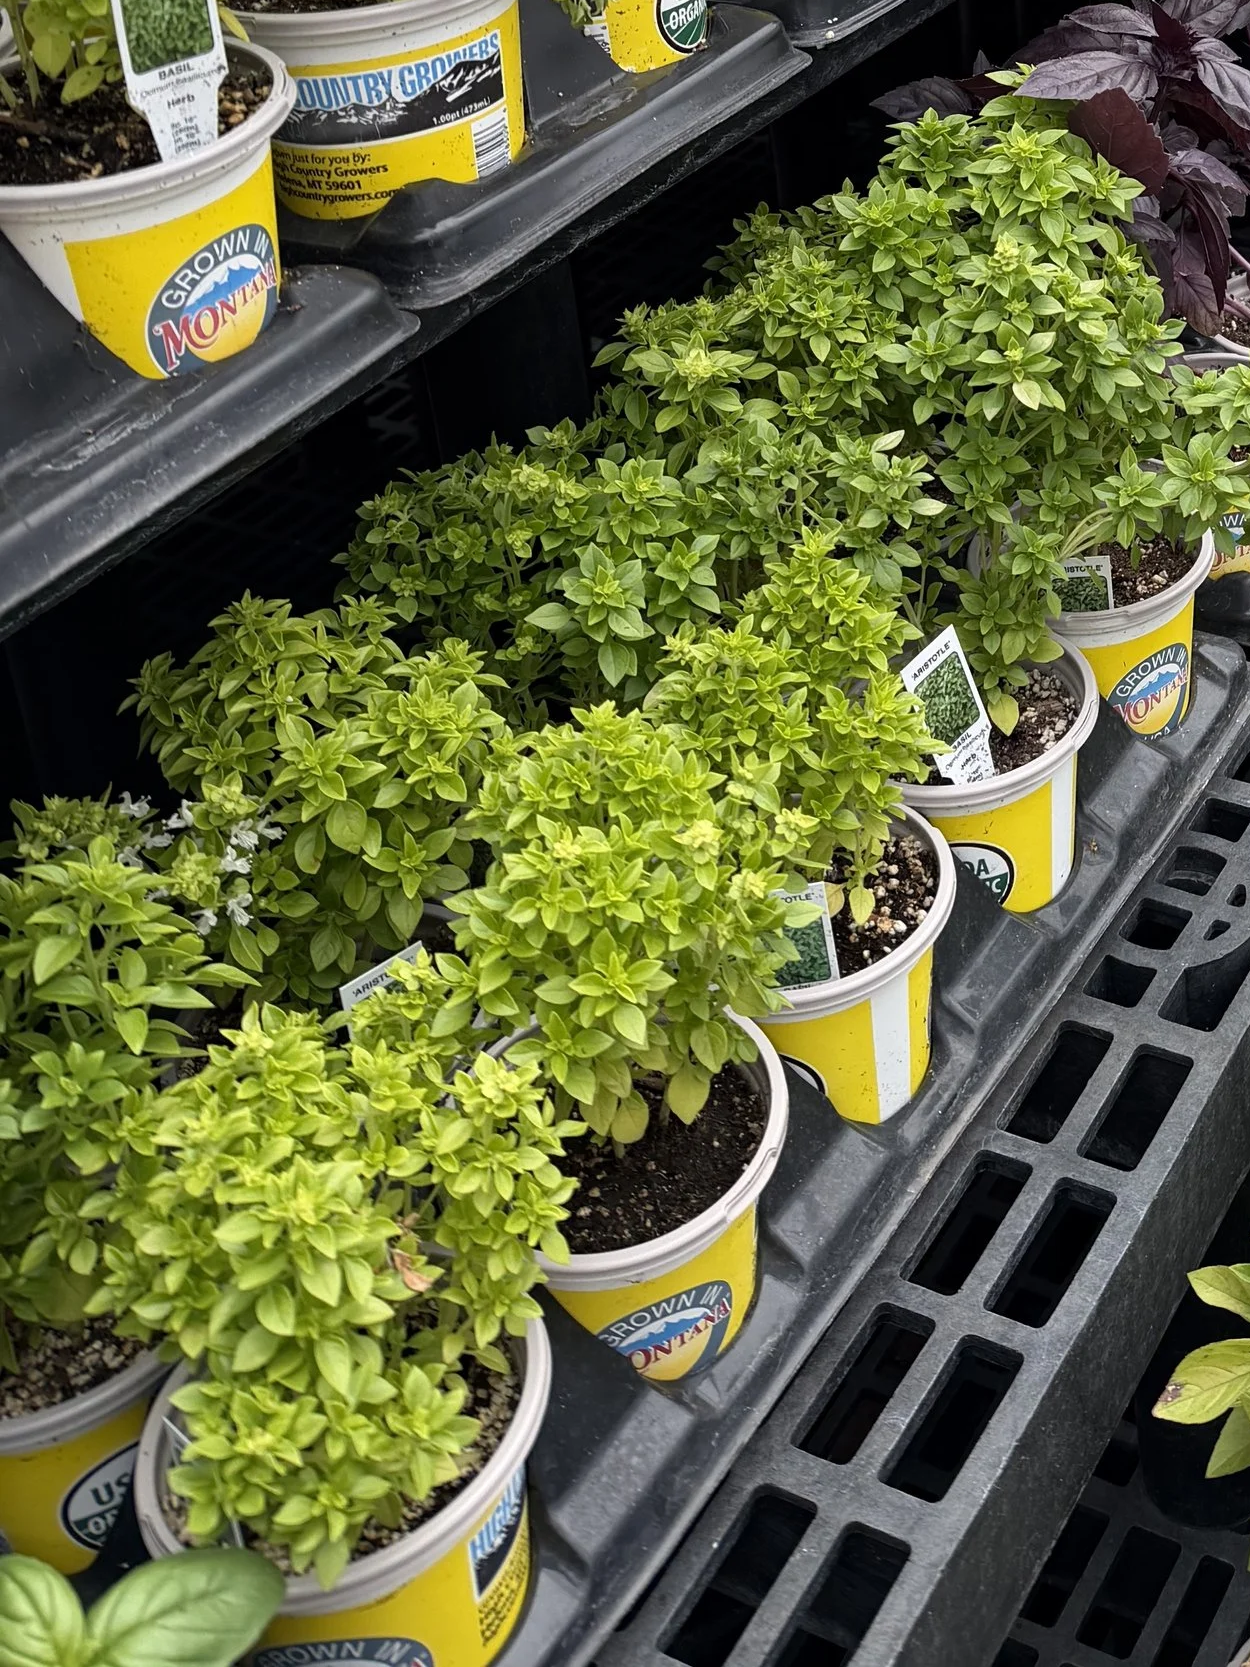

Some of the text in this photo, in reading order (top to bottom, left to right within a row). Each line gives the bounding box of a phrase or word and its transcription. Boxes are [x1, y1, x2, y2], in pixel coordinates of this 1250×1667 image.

[158, 61, 196, 81] BASIL
[399, 32, 500, 100] GROWERS
[166, 94, 196, 110] Herb
[289, 162, 332, 180] Country
[333, 163, 389, 178] Growers
[291, 152, 309, 164] just
[311, 153, 326, 164] for
[328, 155, 351, 167] you
[351, 151, 372, 166] by:
[306, 179, 323, 191] MT
[325, 180, 363, 191] 59601
[161, 228, 270, 310] GROWN IN
[153, 257, 277, 373] MONTANA
[911, 640, 952, 682] 'ARISTOTLE'
[1116, 646, 1187, 697] GROWN IN
[699, 1284, 723, 1306] IN
[629, 1297, 731, 1372] ONTANA
[374, 1640, 412, 1665] IN
